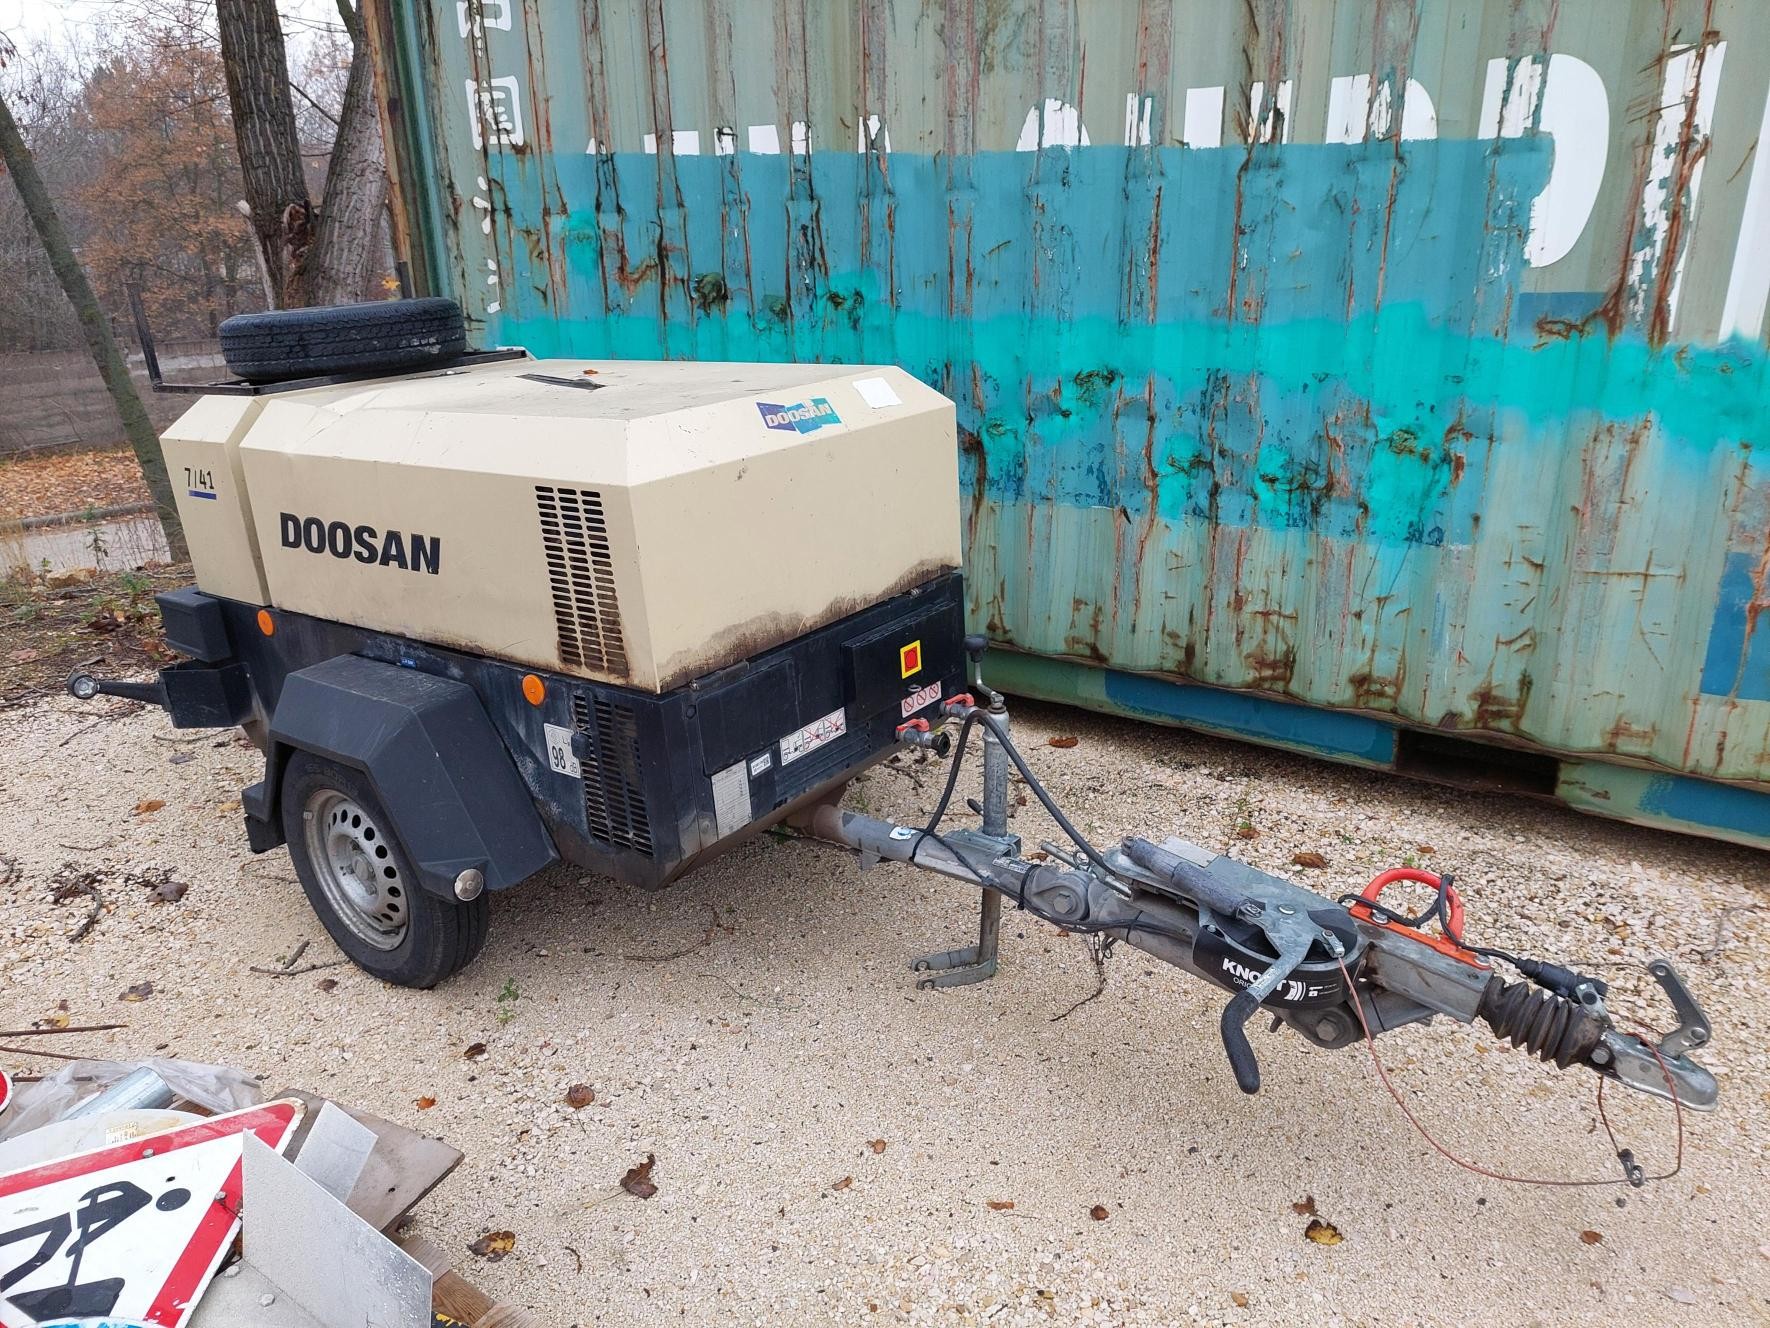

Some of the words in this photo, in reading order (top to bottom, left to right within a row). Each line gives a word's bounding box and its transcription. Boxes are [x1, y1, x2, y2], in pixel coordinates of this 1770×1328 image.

[765, 402, 833, 427] DOOSAN
[280, 511, 440, 575] DOOSAN
[551, 745, 566, 770] 98
